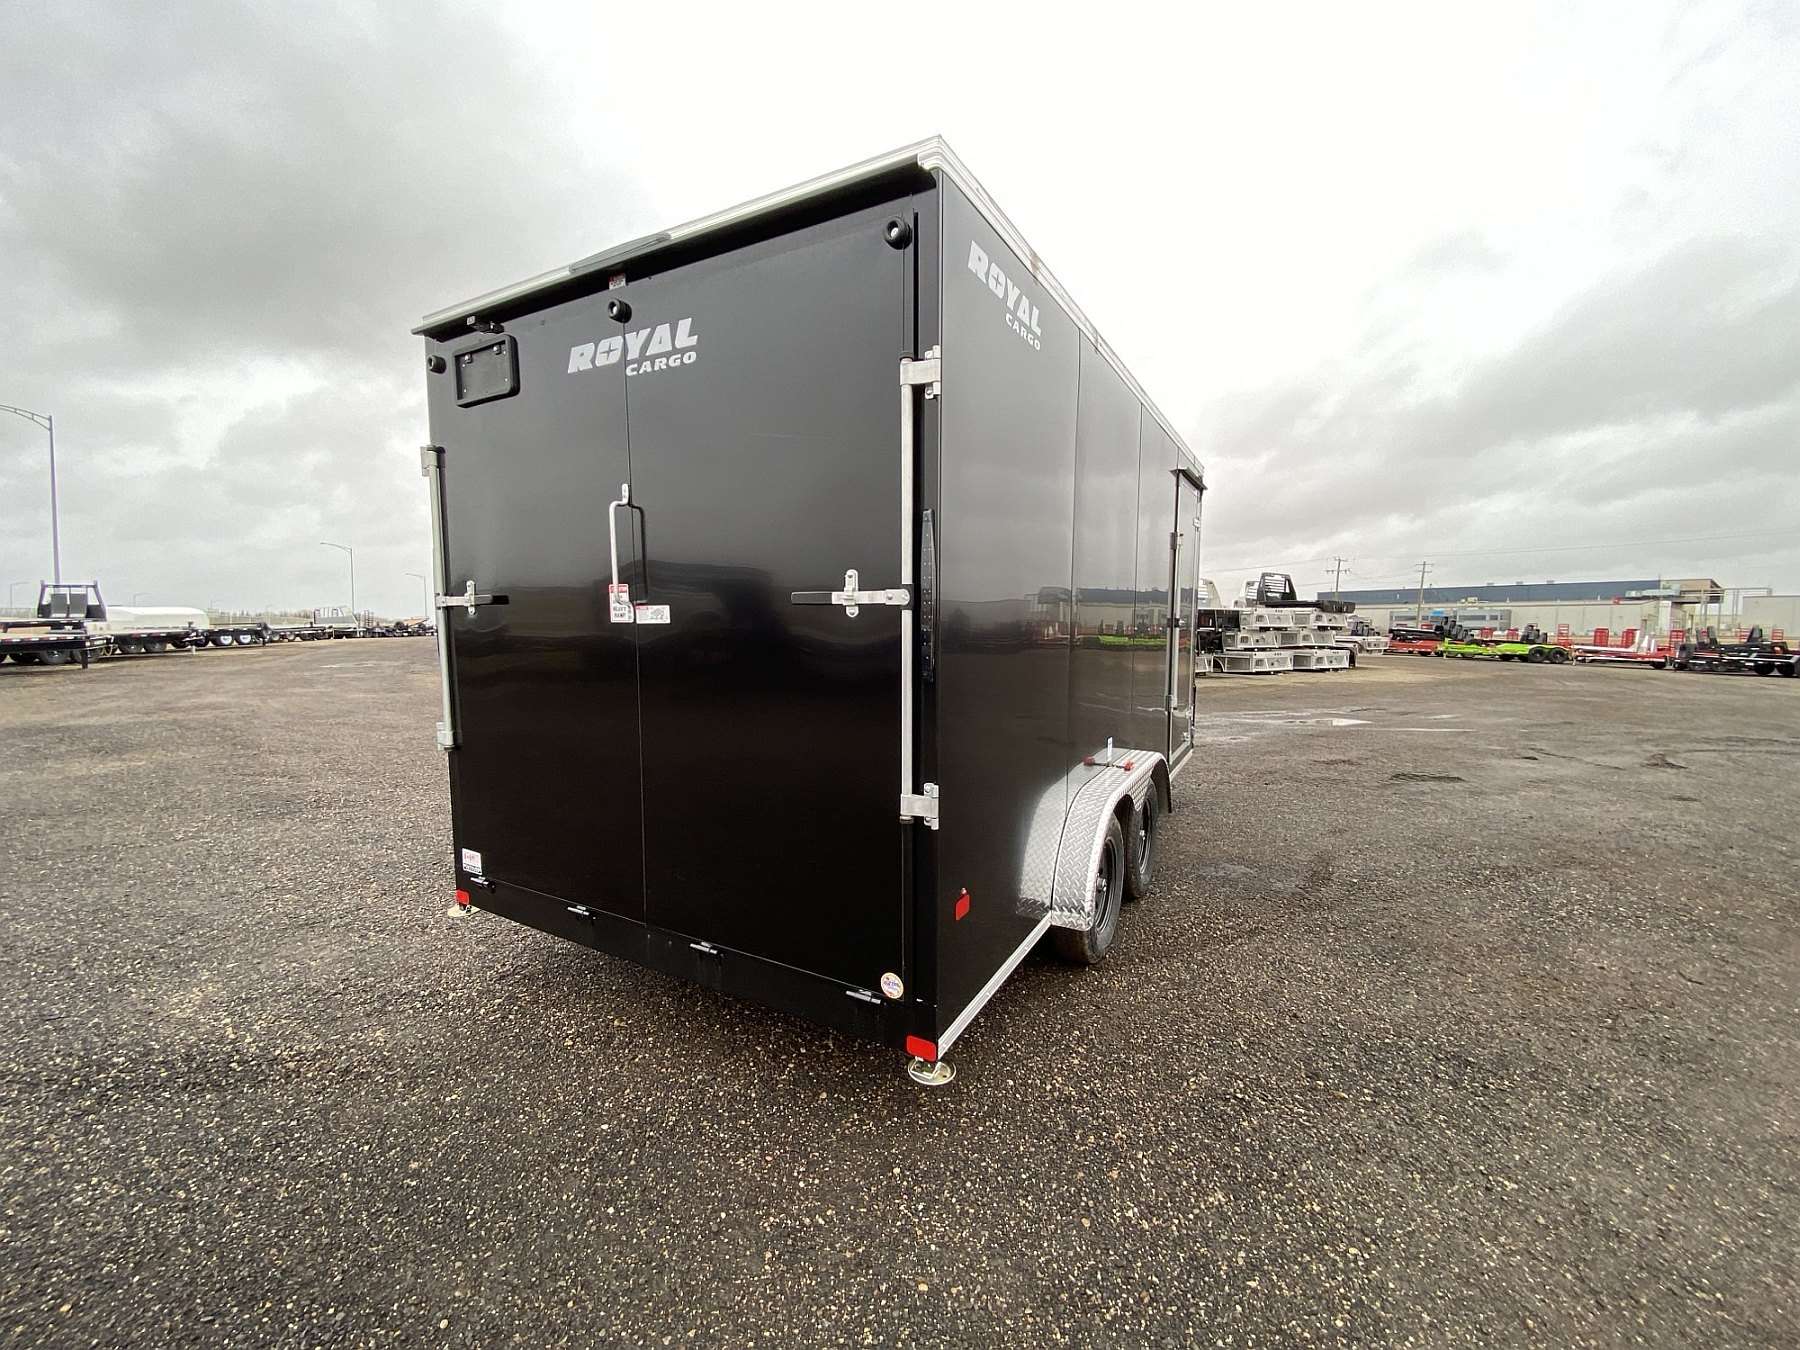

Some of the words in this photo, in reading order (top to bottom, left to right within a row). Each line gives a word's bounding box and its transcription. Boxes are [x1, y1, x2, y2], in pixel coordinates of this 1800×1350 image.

[968, 240, 1041, 336] ROYAL
[568, 318, 698, 374] ROYAL
[1005, 313, 1041, 350] CARGO
[625, 351, 697, 376] CARGO
